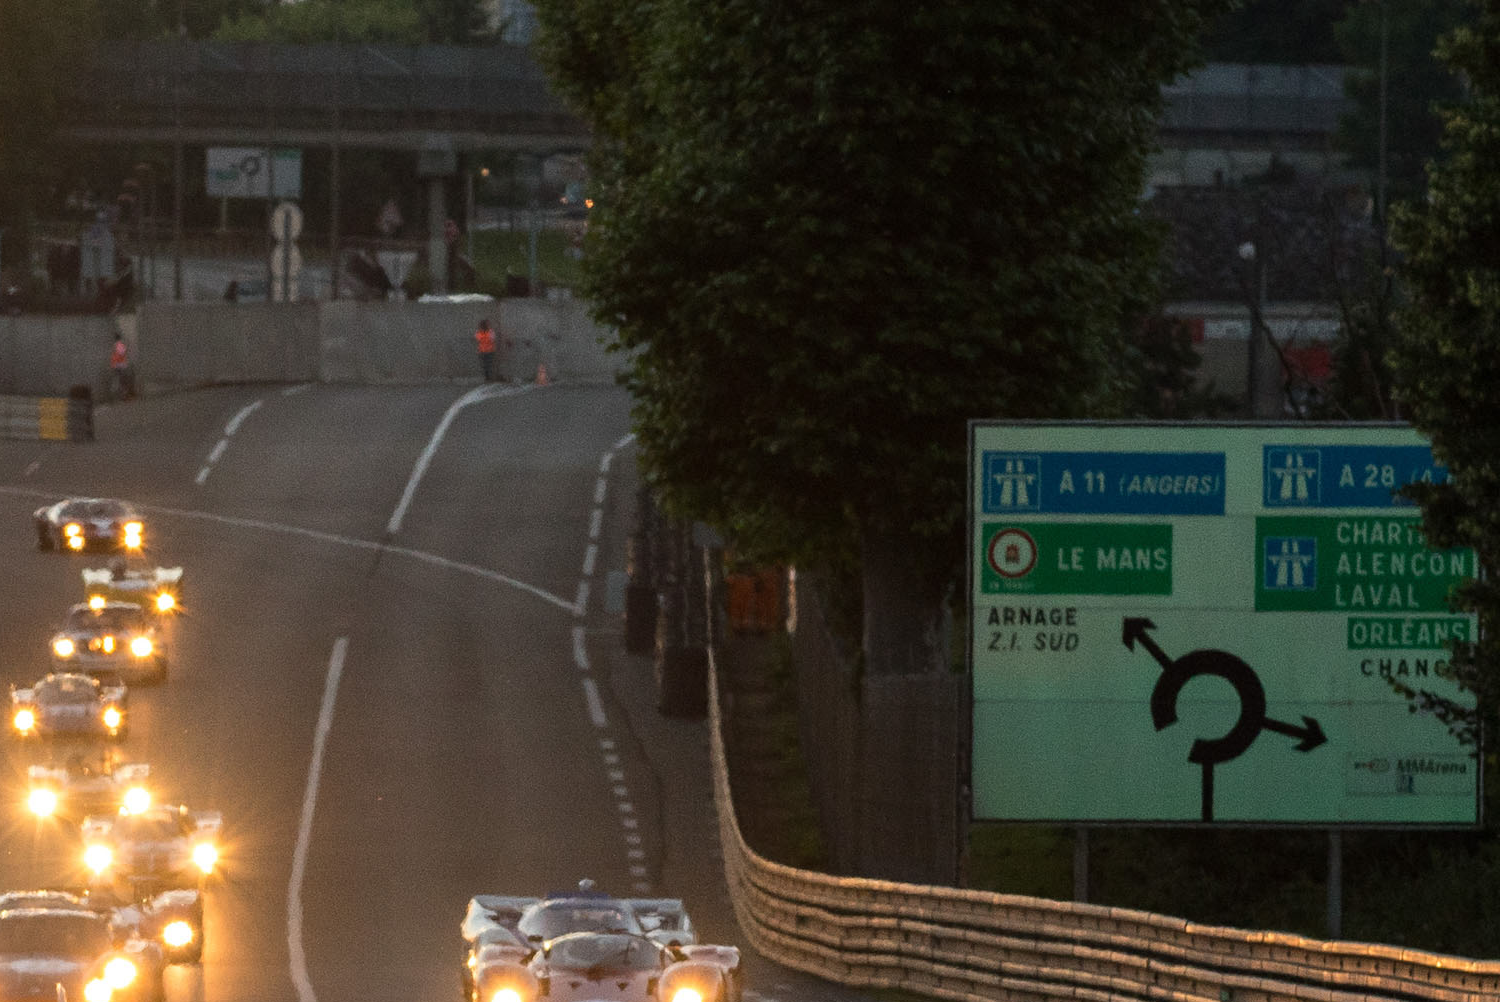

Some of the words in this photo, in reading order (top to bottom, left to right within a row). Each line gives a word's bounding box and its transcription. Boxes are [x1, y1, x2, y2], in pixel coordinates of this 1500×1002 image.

[1059, 469, 1076, 494] A
[1083, 470, 1106, 494] 11
[1119, 473, 1219, 496] (ANGERS)
[1339, 464, 1355, 488] A
[1364, 464, 1396, 488] 28
[1337, 521, 1426, 545] CHART
[1057, 547, 1085, 571] LE
[1097, 547, 1169, 571] MANS
[1335, 584, 1420, 608] LAVAL
[988, 607, 1078, 627] ARNAGE
[988, 633, 1022, 652] Z.I.
[1035, 632, 1080, 652] SUD
[1352, 618, 1466, 645] ORLÉANS
